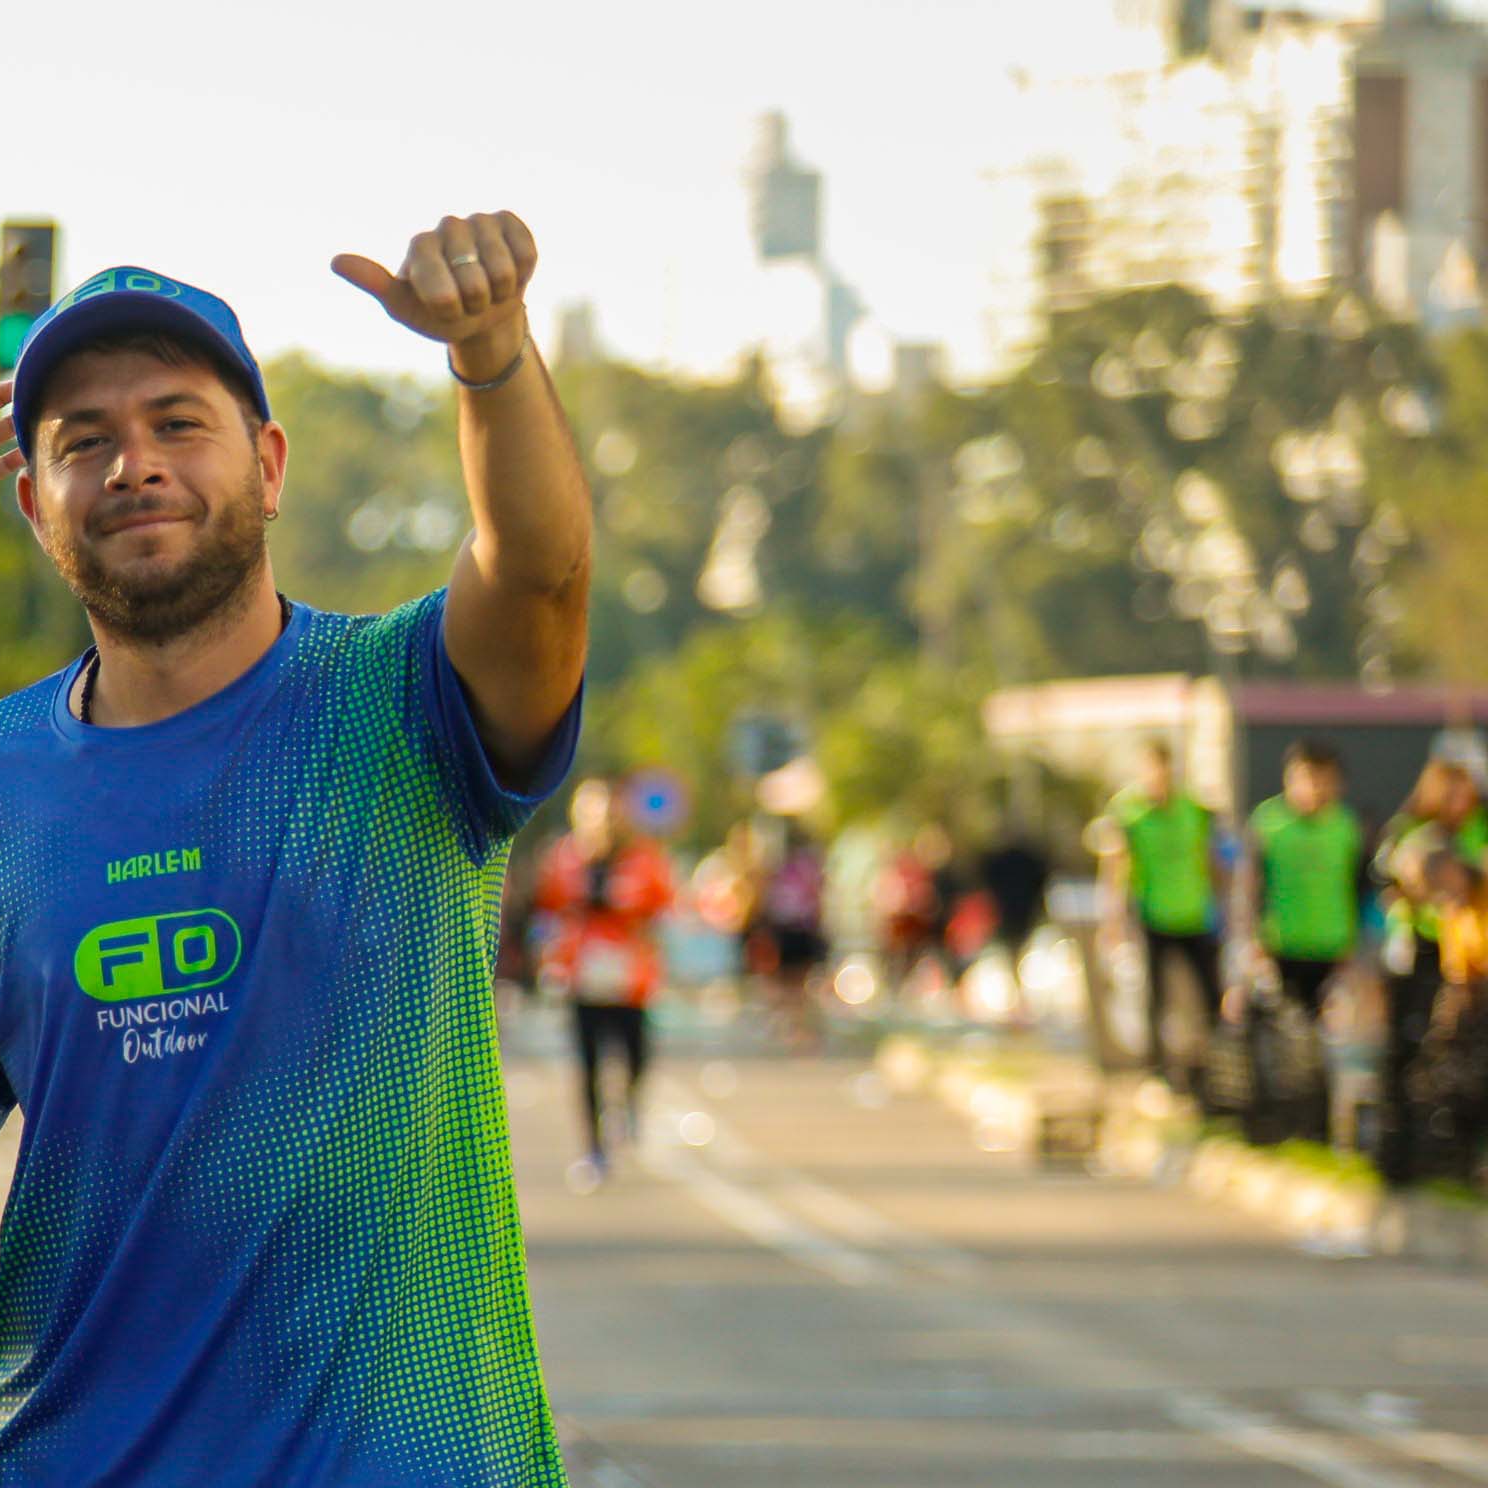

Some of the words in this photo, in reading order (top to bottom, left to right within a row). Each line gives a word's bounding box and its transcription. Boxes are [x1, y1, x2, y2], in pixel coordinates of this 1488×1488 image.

[107, 847, 202, 885] HARLEM
[97, 992, 230, 1031] FUNCIONAL
[123, 1025, 208, 1064] Outdoor
